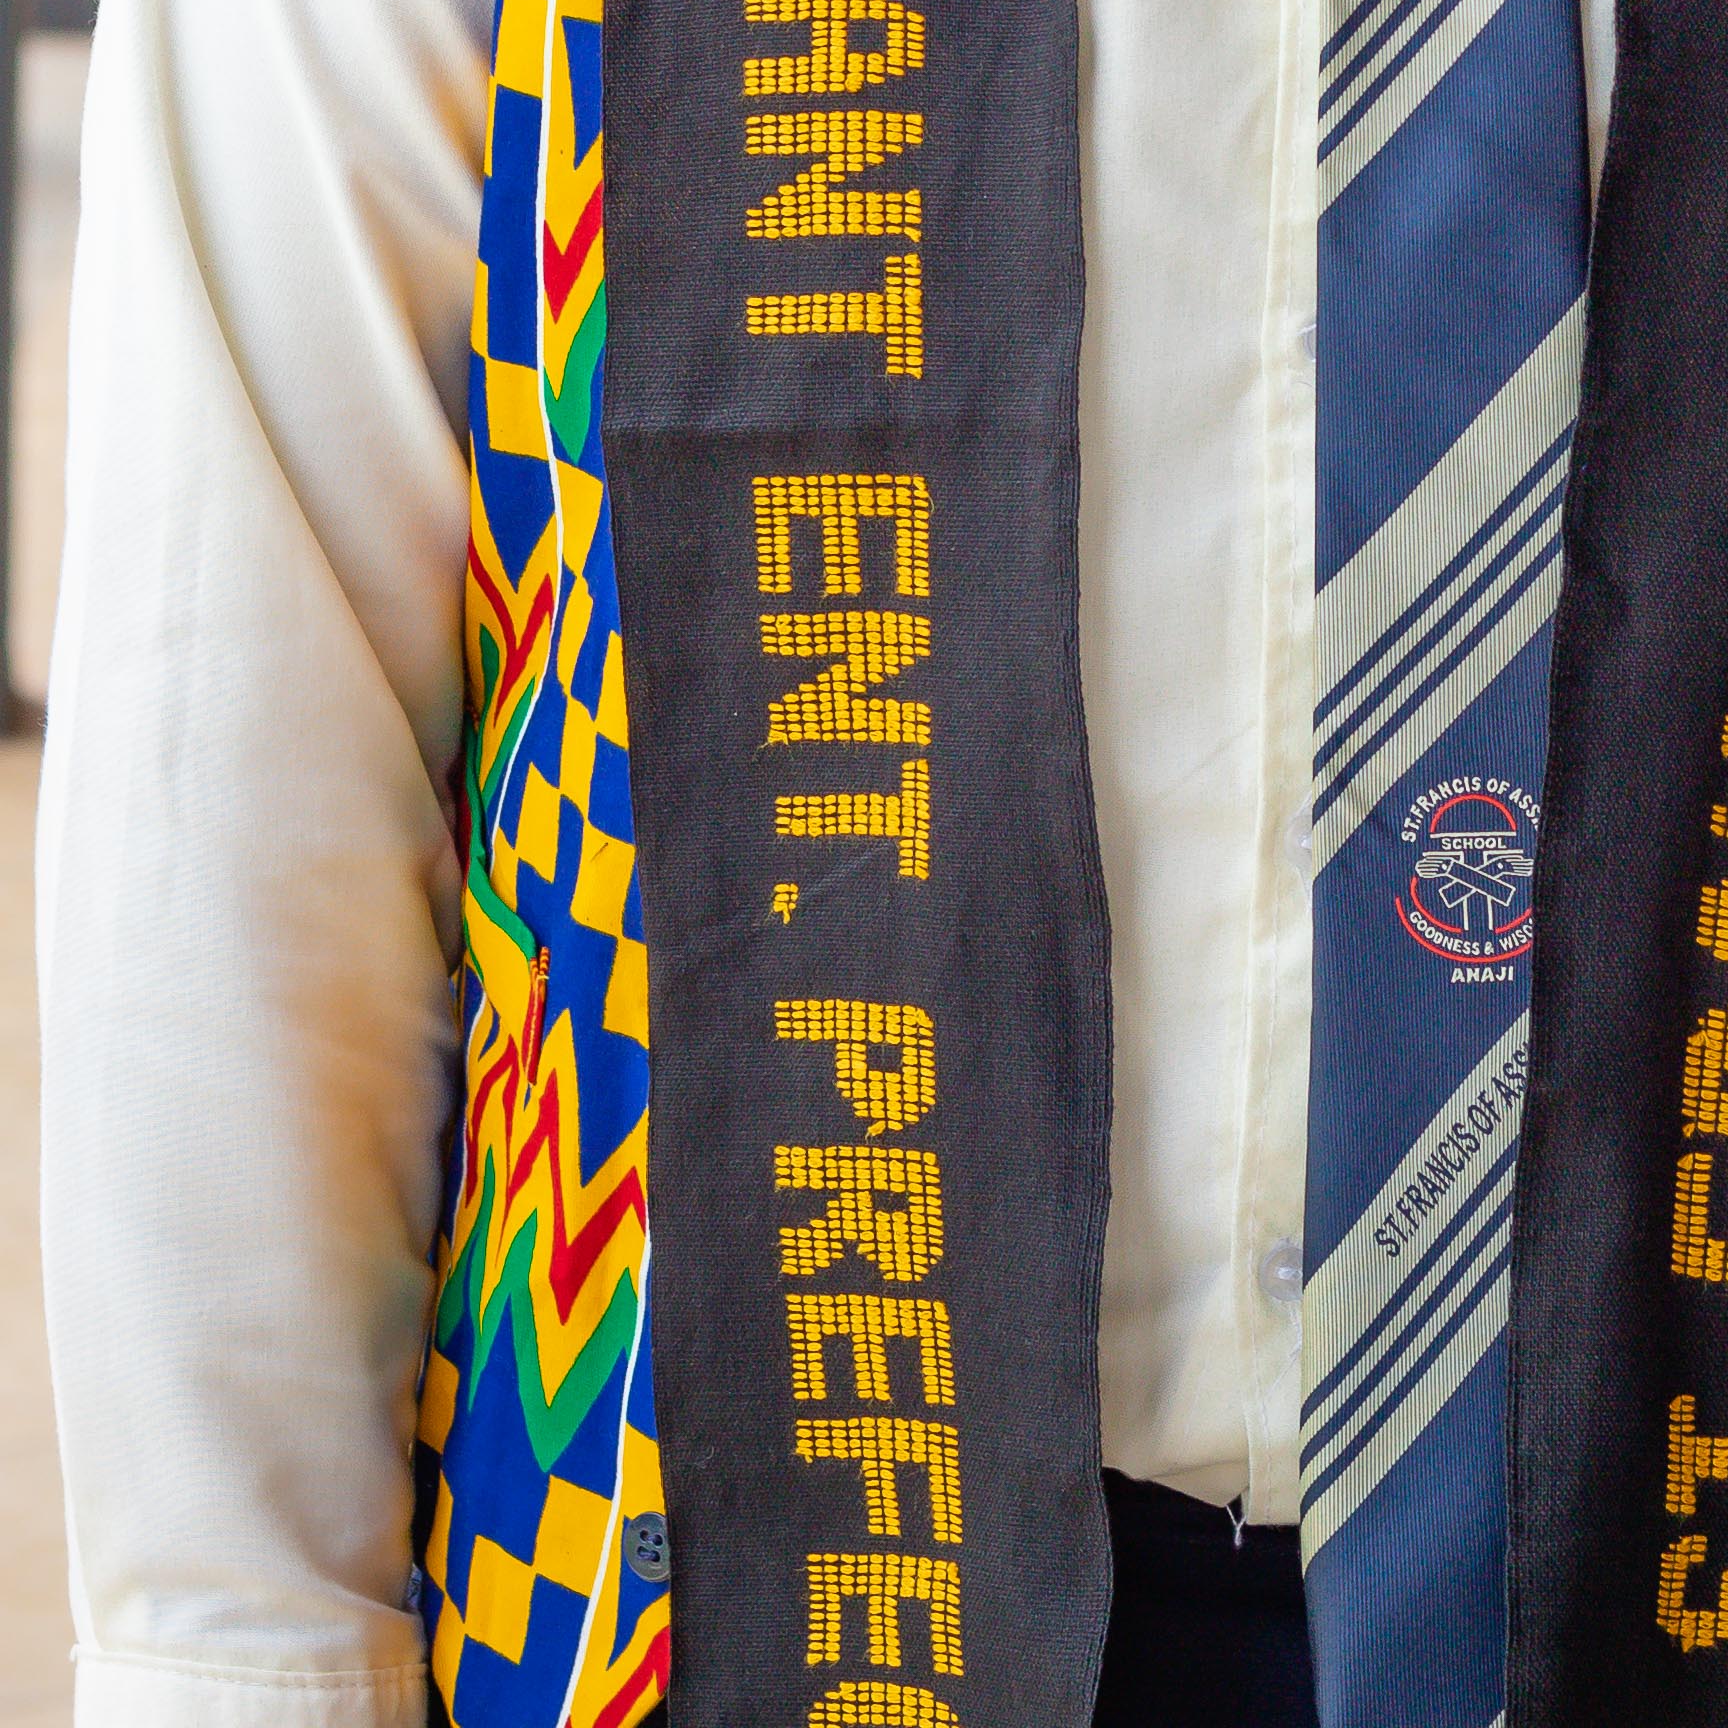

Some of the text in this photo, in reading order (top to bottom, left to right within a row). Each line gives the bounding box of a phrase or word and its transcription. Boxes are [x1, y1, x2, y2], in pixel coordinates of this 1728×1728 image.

[751, 472, 933, 924] ENT.
[1486, 777, 1511, 795] OF
[1441, 837, 1507, 850] SCHOOL
[1409, 911, 1480, 956] GOODNESS
[1484, 941, 1496, 956] &
[1450, 965, 1514, 984] ANAJI
[1467, 1090, 1502, 1136] OF
